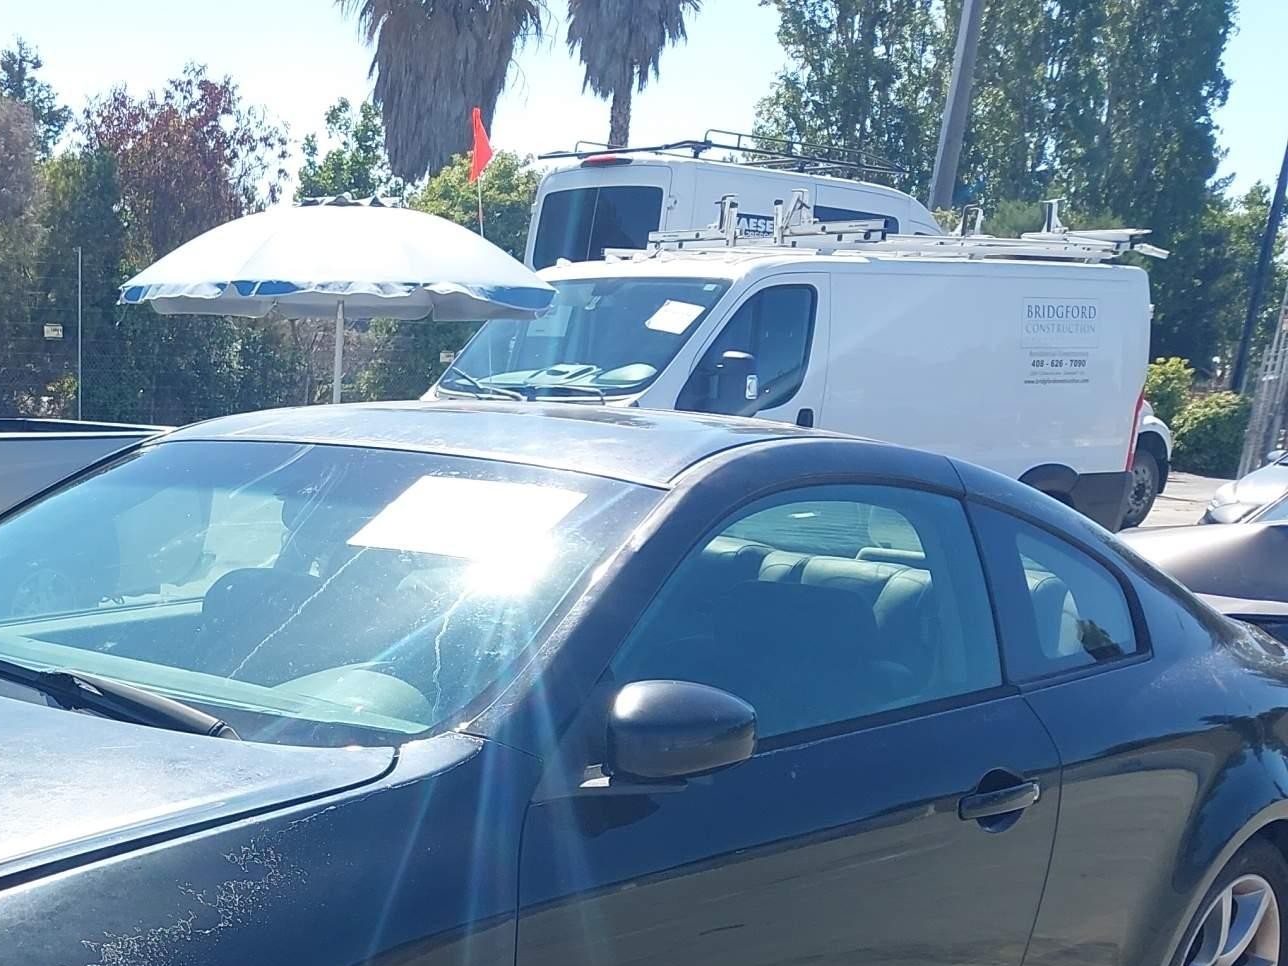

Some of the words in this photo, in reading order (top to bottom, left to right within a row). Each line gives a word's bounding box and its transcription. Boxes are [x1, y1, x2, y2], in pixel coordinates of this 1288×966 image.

[736, 217, 774, 232] AESE
[1027, 305, 1097, 320] BRIDGFORD
[1025, 322, 1097, 334] CONSTRUCTION
